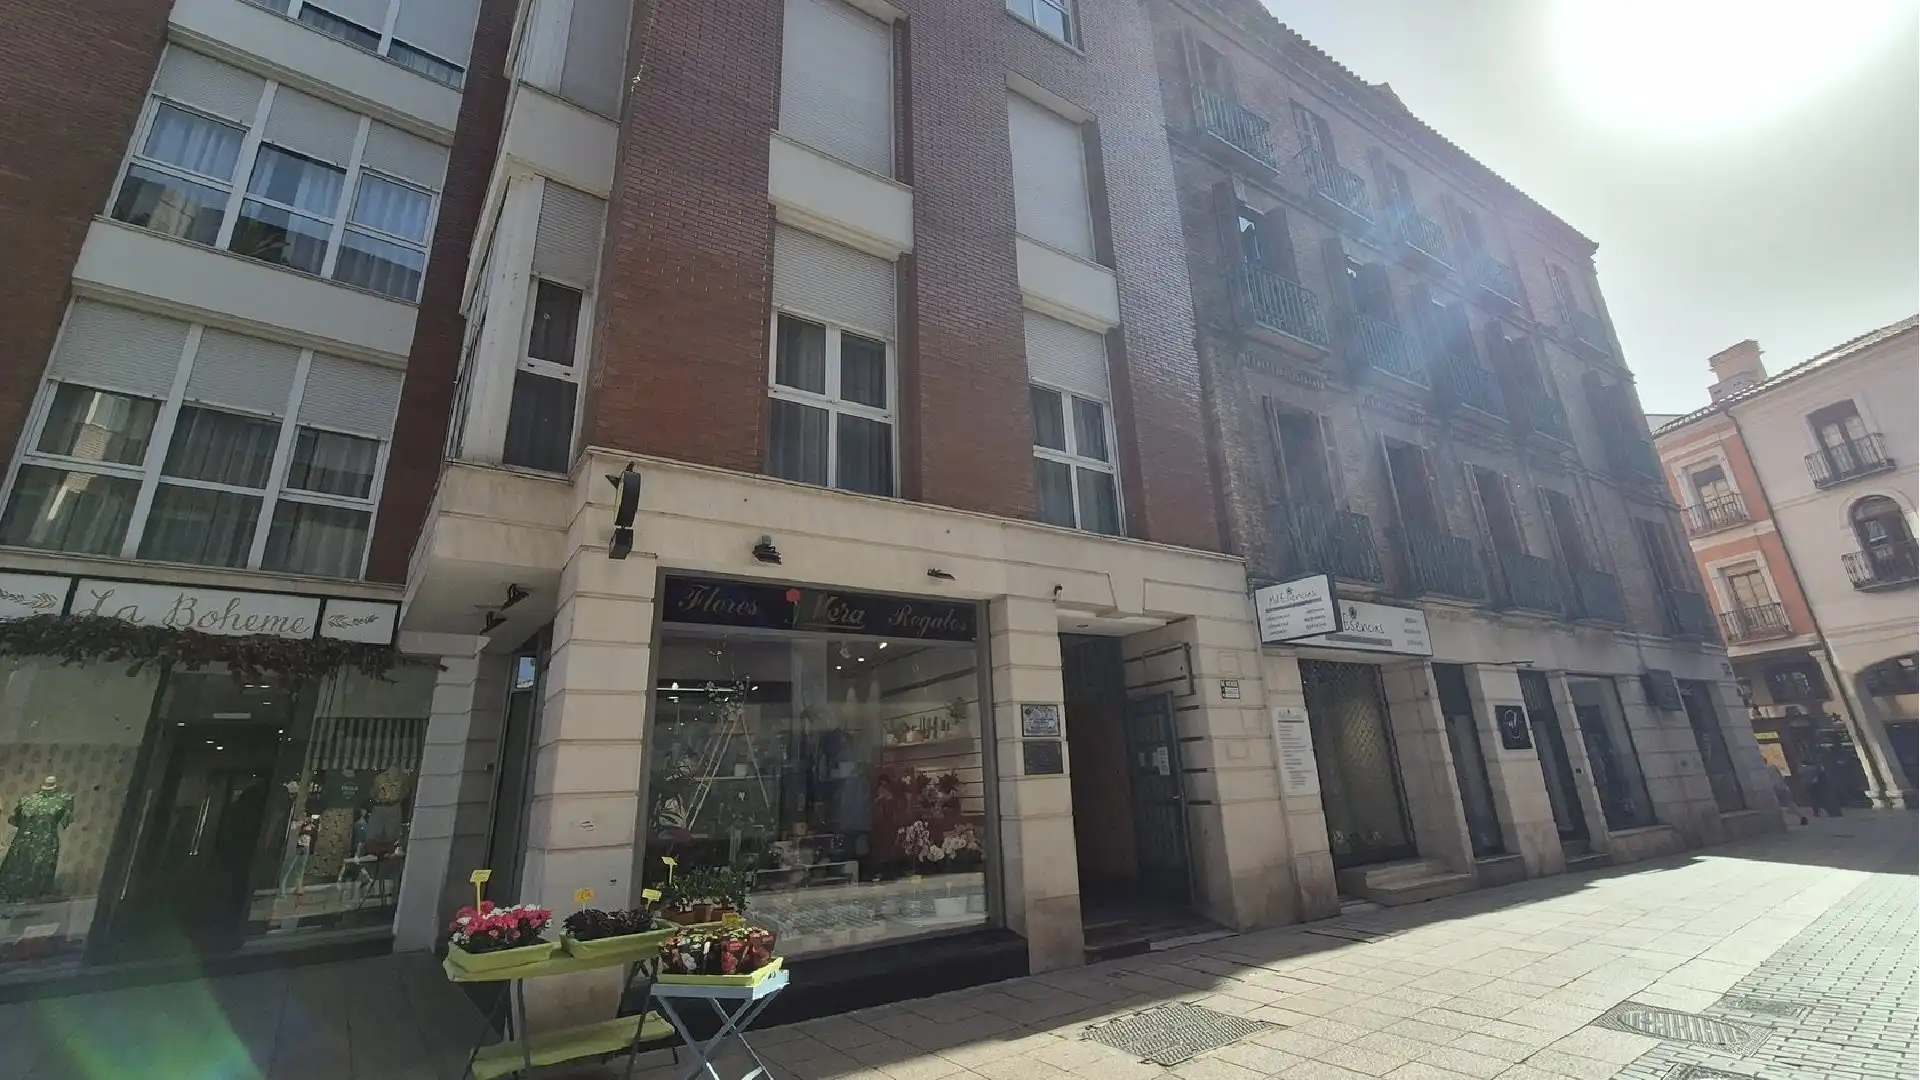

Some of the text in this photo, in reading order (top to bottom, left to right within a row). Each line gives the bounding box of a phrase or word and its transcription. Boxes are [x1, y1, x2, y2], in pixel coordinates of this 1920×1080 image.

[77, 589, 311, 633] La Boheme
[678, 584, 758, 616] Flores
[888, 604, 967, 637] Regalos
